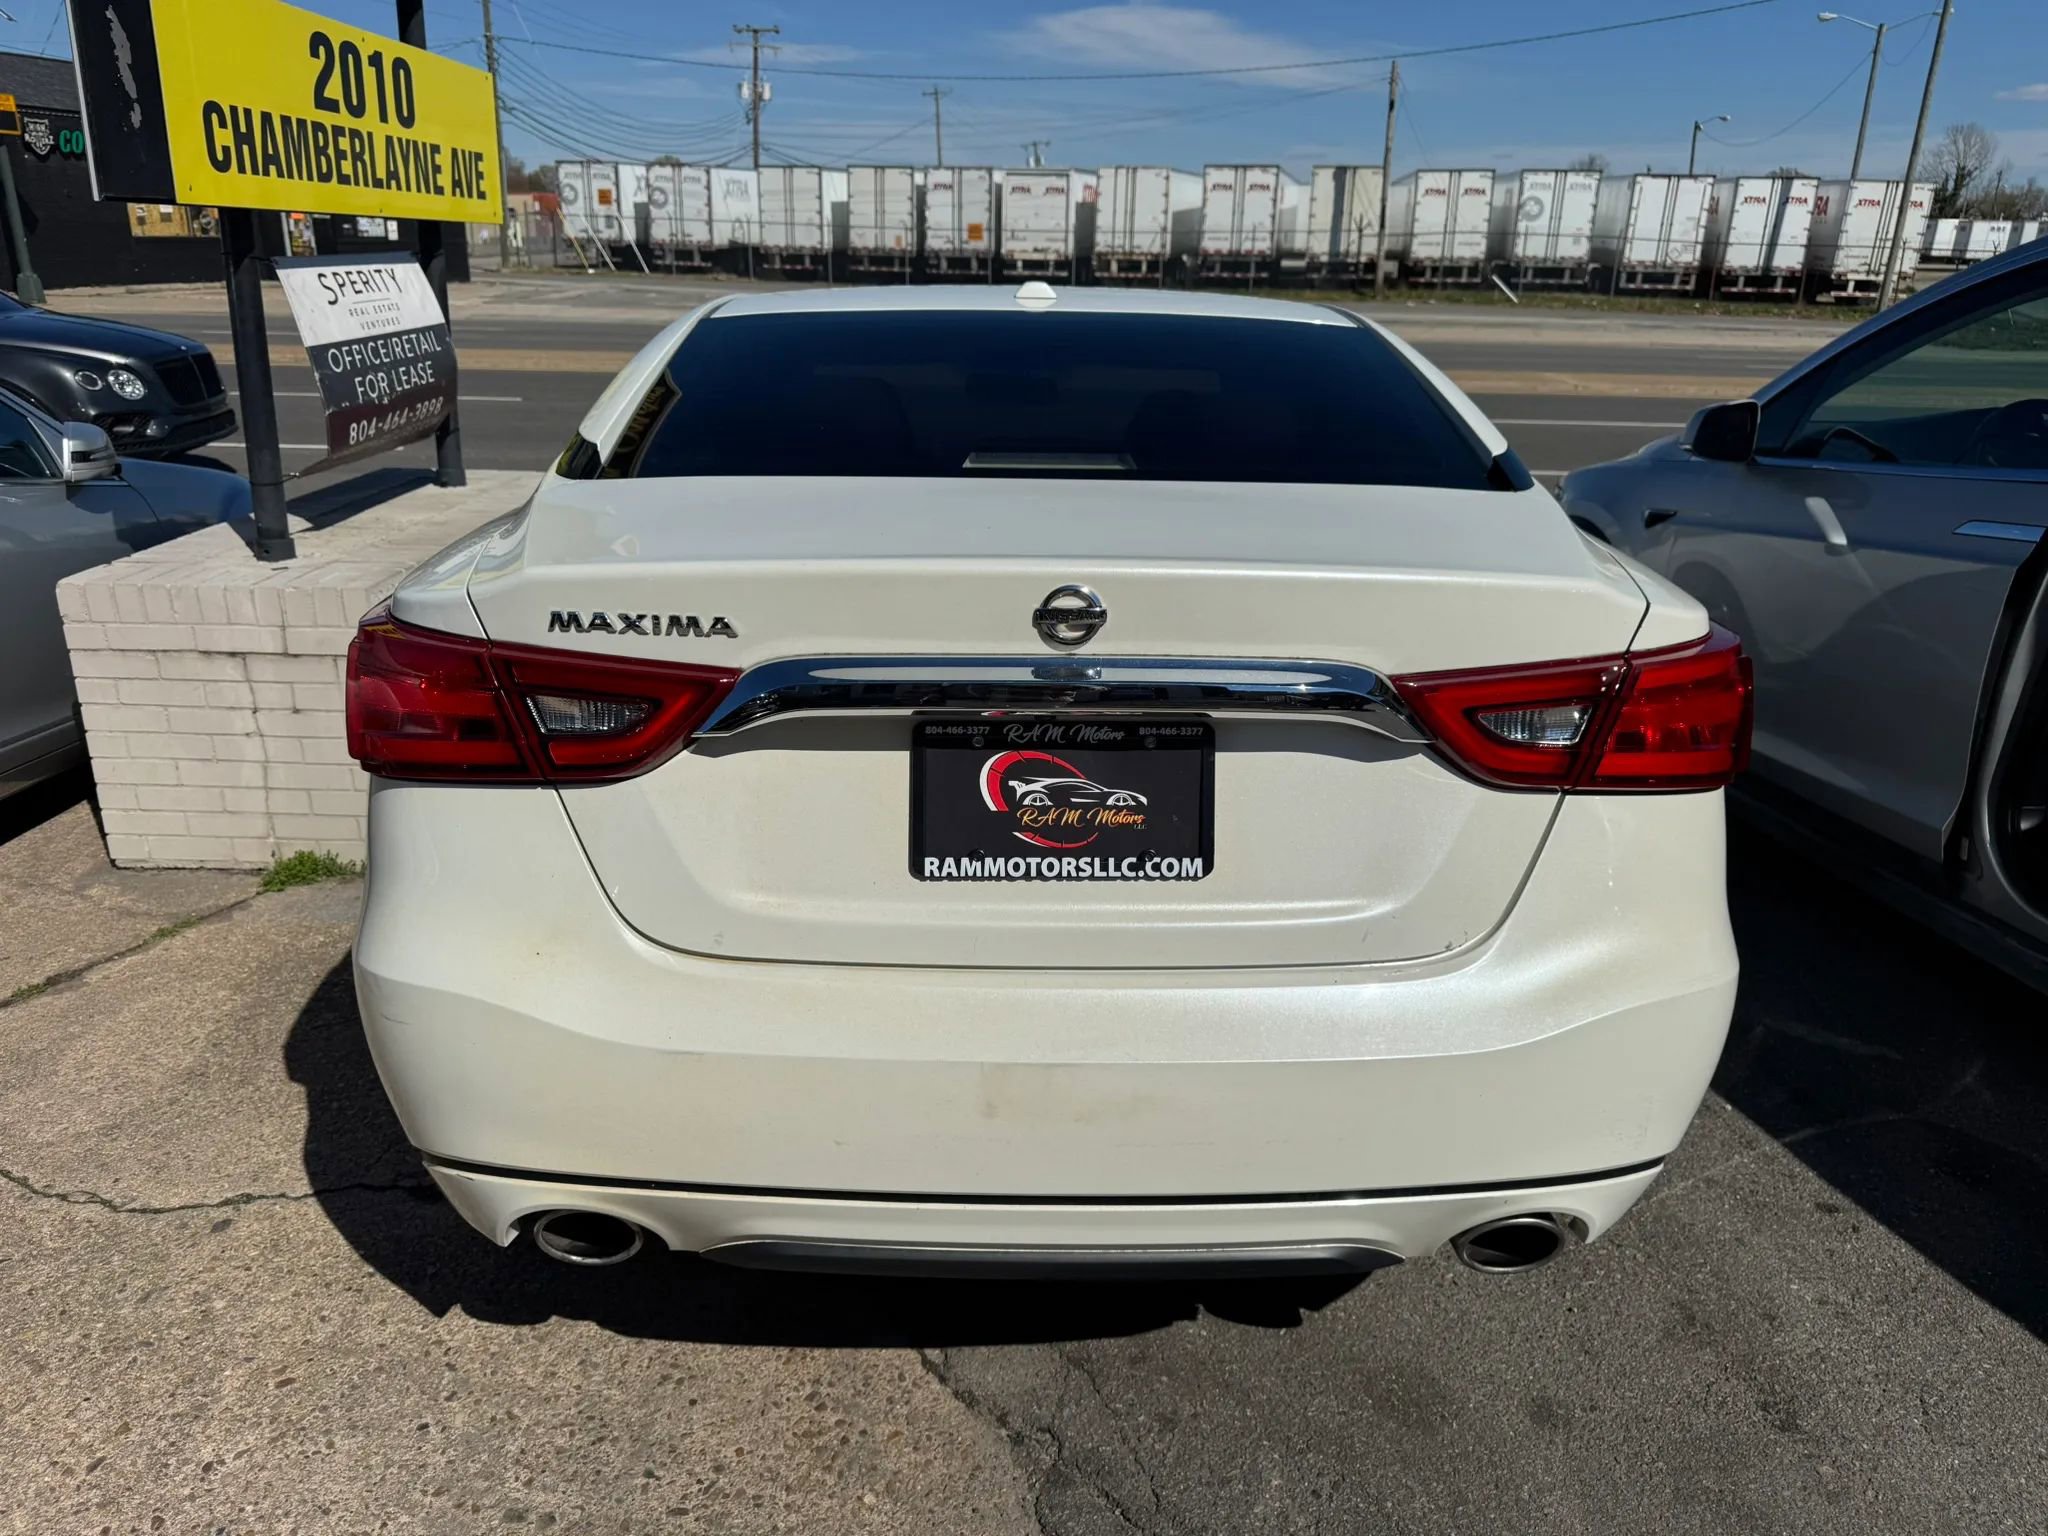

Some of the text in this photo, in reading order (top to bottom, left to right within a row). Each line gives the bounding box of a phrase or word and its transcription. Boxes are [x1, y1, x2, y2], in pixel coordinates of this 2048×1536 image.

[309, 30, 416, 130] 2010
[202, 99, 487, 201] CHAMBERLAYNE AVE
[317, 268, 404, 306] SPERITY
[348, 304, 370, 318] REAL
[360, 316, 402, 332] VENTURES
[327, 330, 442, 374] OFFICE/RETAIL
[354, 360, 436, 404] FOR LEASE
[348, 395, 445, 446] 804-464-3898
[547, 610, 740, 639] MAXIMA
[924, 725, 991, 736] 804-466-3377
[1002, 723, 1126, 744] RAM Motors
[1138, 726, 1204, 737] 804-466-3377
[1016, 807, 1147, 828] RAM Motors
[924, 856, 1204, 878] RAMMOTORSLLC.COM
